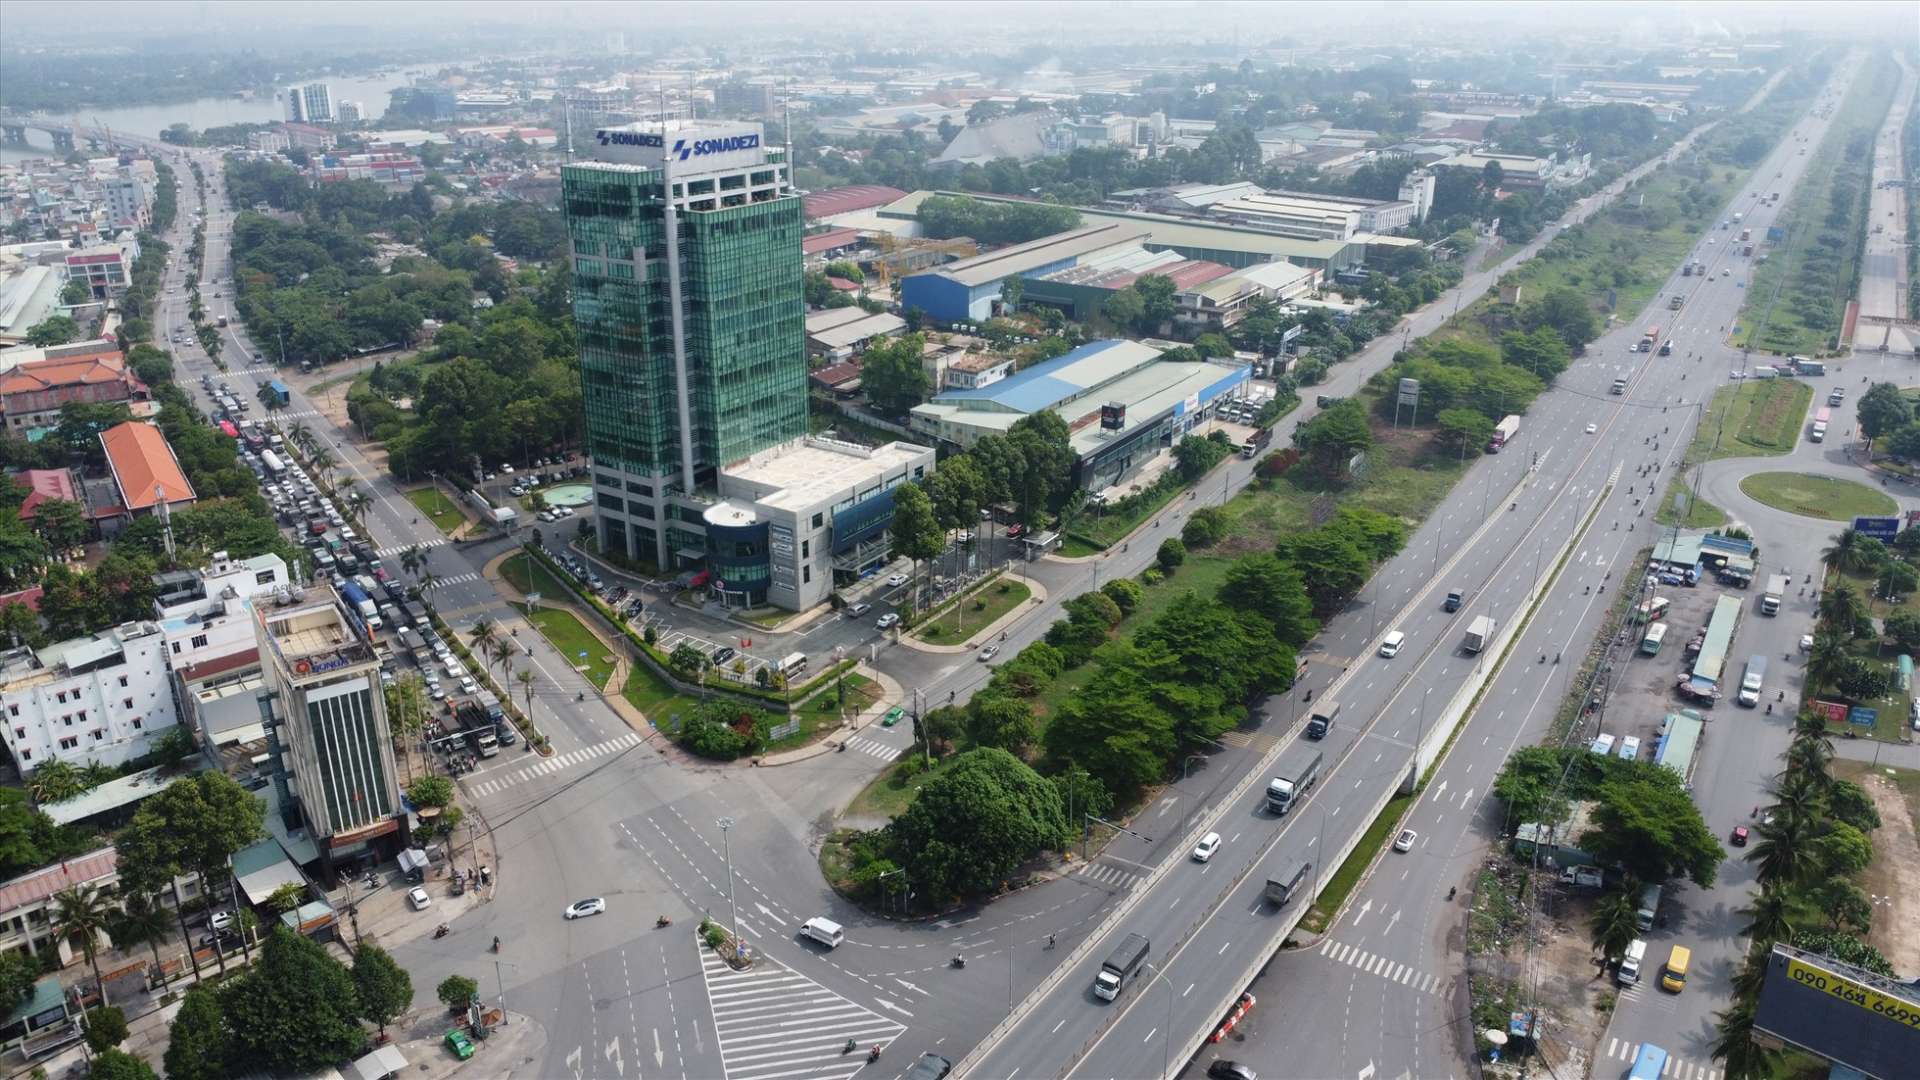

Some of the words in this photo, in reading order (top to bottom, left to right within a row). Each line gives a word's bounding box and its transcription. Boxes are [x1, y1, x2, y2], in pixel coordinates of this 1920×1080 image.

[611, 132, 663, 147] SONADEZI
[693, 134, 759, 155] SONADEZI
[1793, 968, 1826, 990] 090
[1831, 985, 1866, 1005] 464
[1873, 1001, 1920, 1025] 6699
